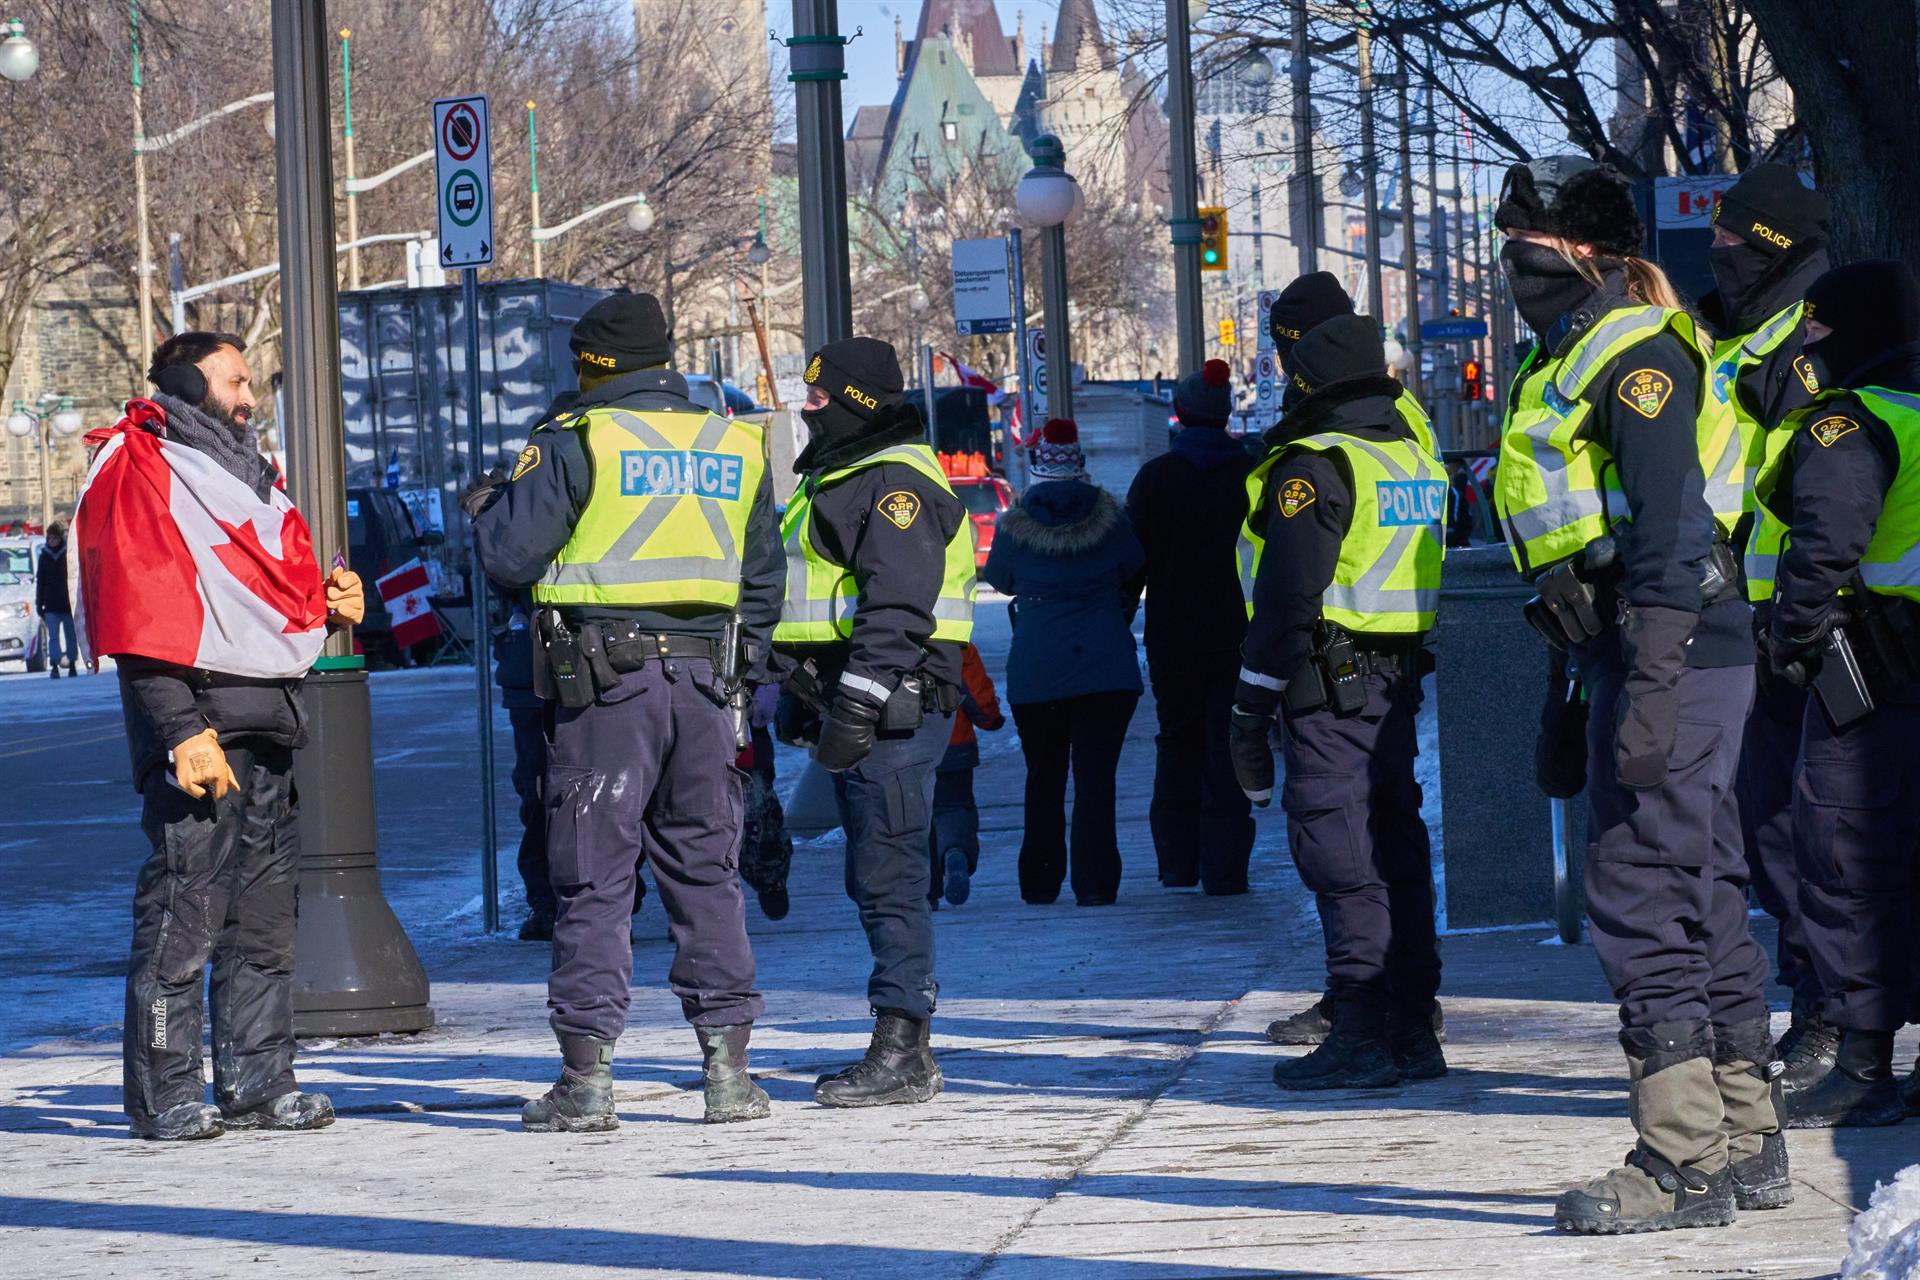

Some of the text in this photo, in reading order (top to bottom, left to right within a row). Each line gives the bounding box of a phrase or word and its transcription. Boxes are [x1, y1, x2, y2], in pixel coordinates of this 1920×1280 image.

[1752, 222, 1793, 249] POLICE
[1276, 323, 1300, 340] POLICE
[580, 351, 617, 368] POLICE
[1293, 373, 1313, 394] POLIC
[625, 455, 739, 495] POLICE
[152, 998, 167, 1049] kamik
